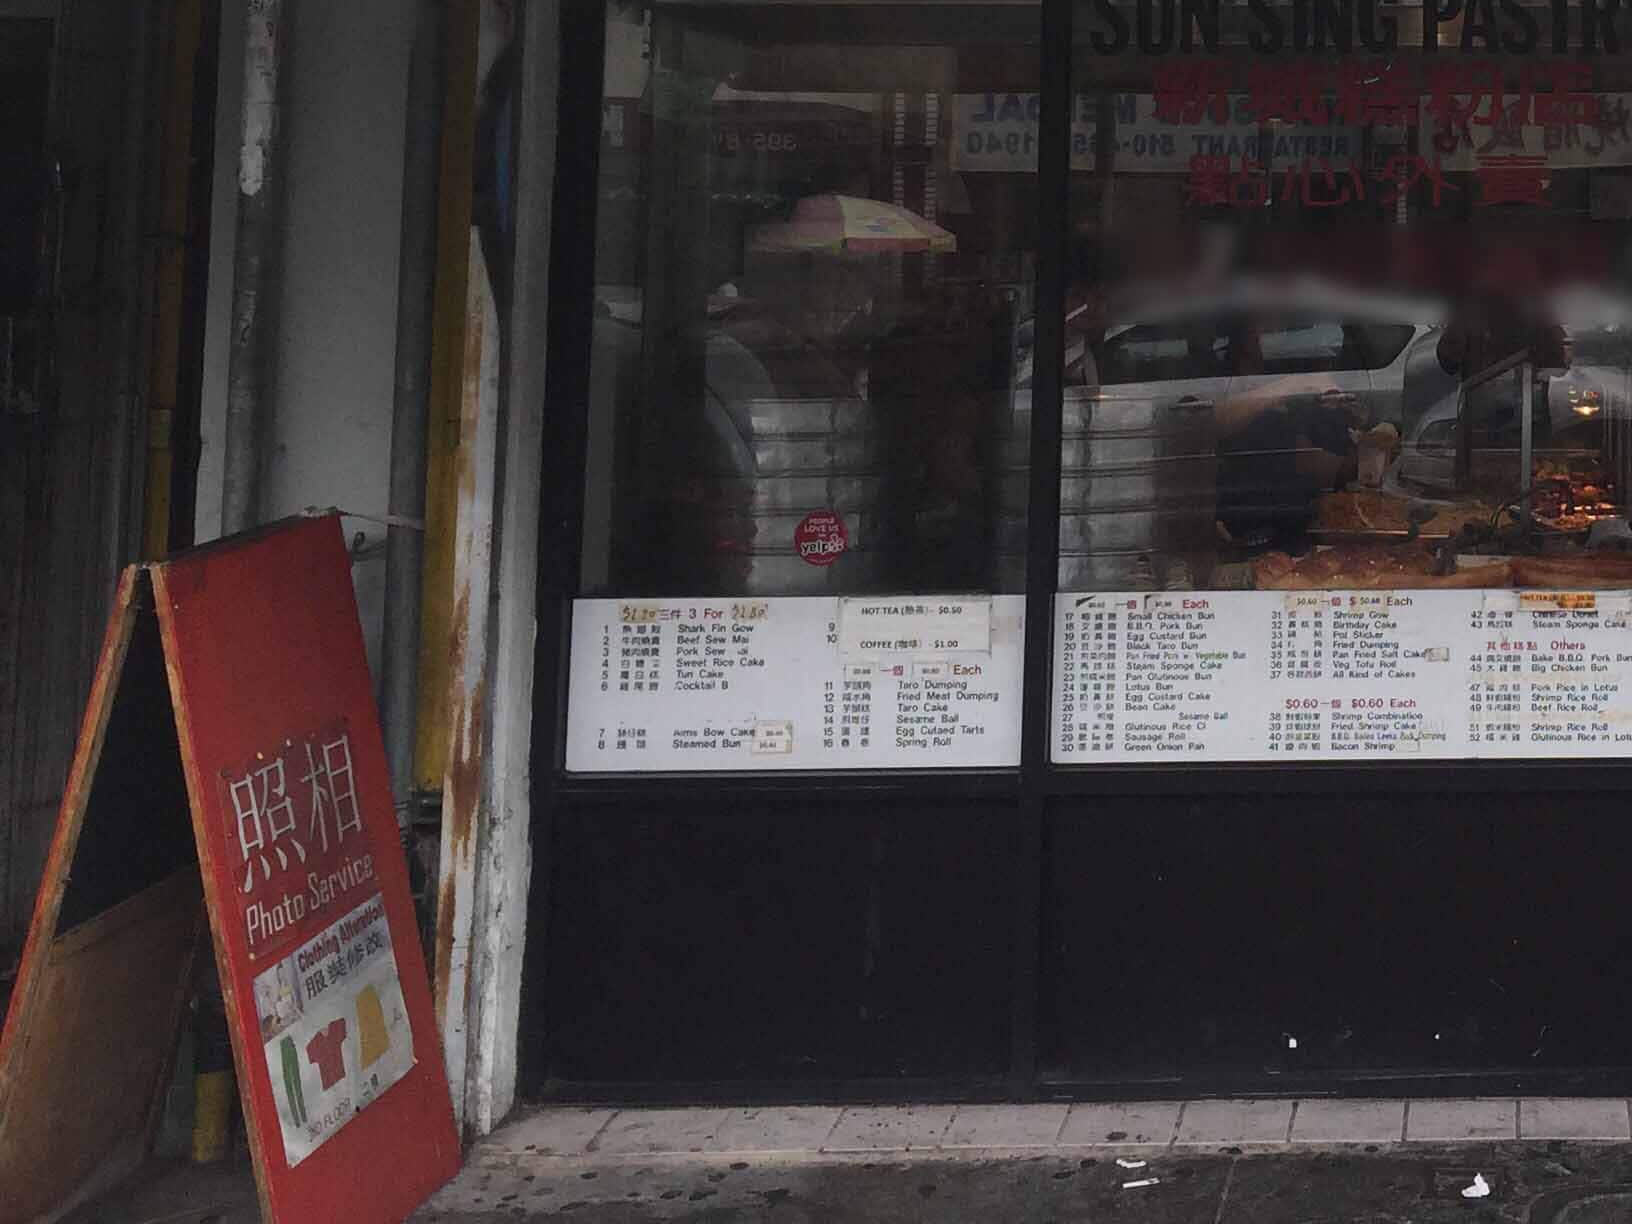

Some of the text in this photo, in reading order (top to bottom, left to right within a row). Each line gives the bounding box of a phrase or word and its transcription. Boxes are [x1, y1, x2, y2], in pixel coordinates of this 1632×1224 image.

[800, 540, 831, 556] yelp
[1183, 600, 1209, 609] Each
[1386, 597, 1413, 606] Each
[704, 609, 723, 619] For
[861, 606, 899, 615] HOT TEA
[1369, 611, 1389, 619] Gow
[1128, 612, 1215, 621] Small Bun
[678, 624, 754, 633] Shark Fin Gow
[1333, 621, 1397, 630] Birthday Cake
[1566, 620, 1599, 629] Sponge
[677, 636, 700, 644] Beef
[705, 636, 726, 644] Sew
[1127, 632, 1207, 641] Egg Custard Bun
[860, 640, 958, 649] COFFEE $1.00
[1333, 641, 1355, 649] Fried
[1550, 640, 1585, 650] Others
[676, 647, 726, 655] Pork Sew
[1403, 650, 1425, 658] Cake
[676, 658, 706, 667] Sweet
[713, 658, 735, 667] Rice
[1160, 662, 1194, 671] Sponge
[1333, 661, 1350, 670] Veg
[953, 665, 982, 675] Each
[1551, 663, 1585, 672] Chicken
[699, 670, 724, 678] Cake
[1388, 670, 1415, 678] Cakes
[675, 681, 716, 690] Cocktail
[1125, 683, 1150, 691] Lotus
[897, 692, 921, 701] Fried
[956, 691, 999, 702] Dumping
[1125, 693, 1143, 702] Egg
[1188, 693, 1211, 701] Cake
[1531, 694, 1562, 702] Shrimp
[897, 703, 948, 712] Taro Cake
[1153, 703, 1176, 711] Cake
[1286, 698, 1416, 709] $0.60 $0.60 Each
[896, 715, 935, 724] Sesame
[1331, 712, 1423, 721] Shrimp Combination
[896, 725, 984, 736] Egg Tarts
[1567, 723, 1586, 731] Rice
[703, 728, 725, 737] Bow
[672, 739, 716, 749] Steamed
[722, 739, 741, 748] Bun
[896, 737, 951, 747] Spring Roll
[1124, 743, 1152, 751] Green
[230, 735, 362, 894] 照相
[246, 852, 374, 945] Photo Service
